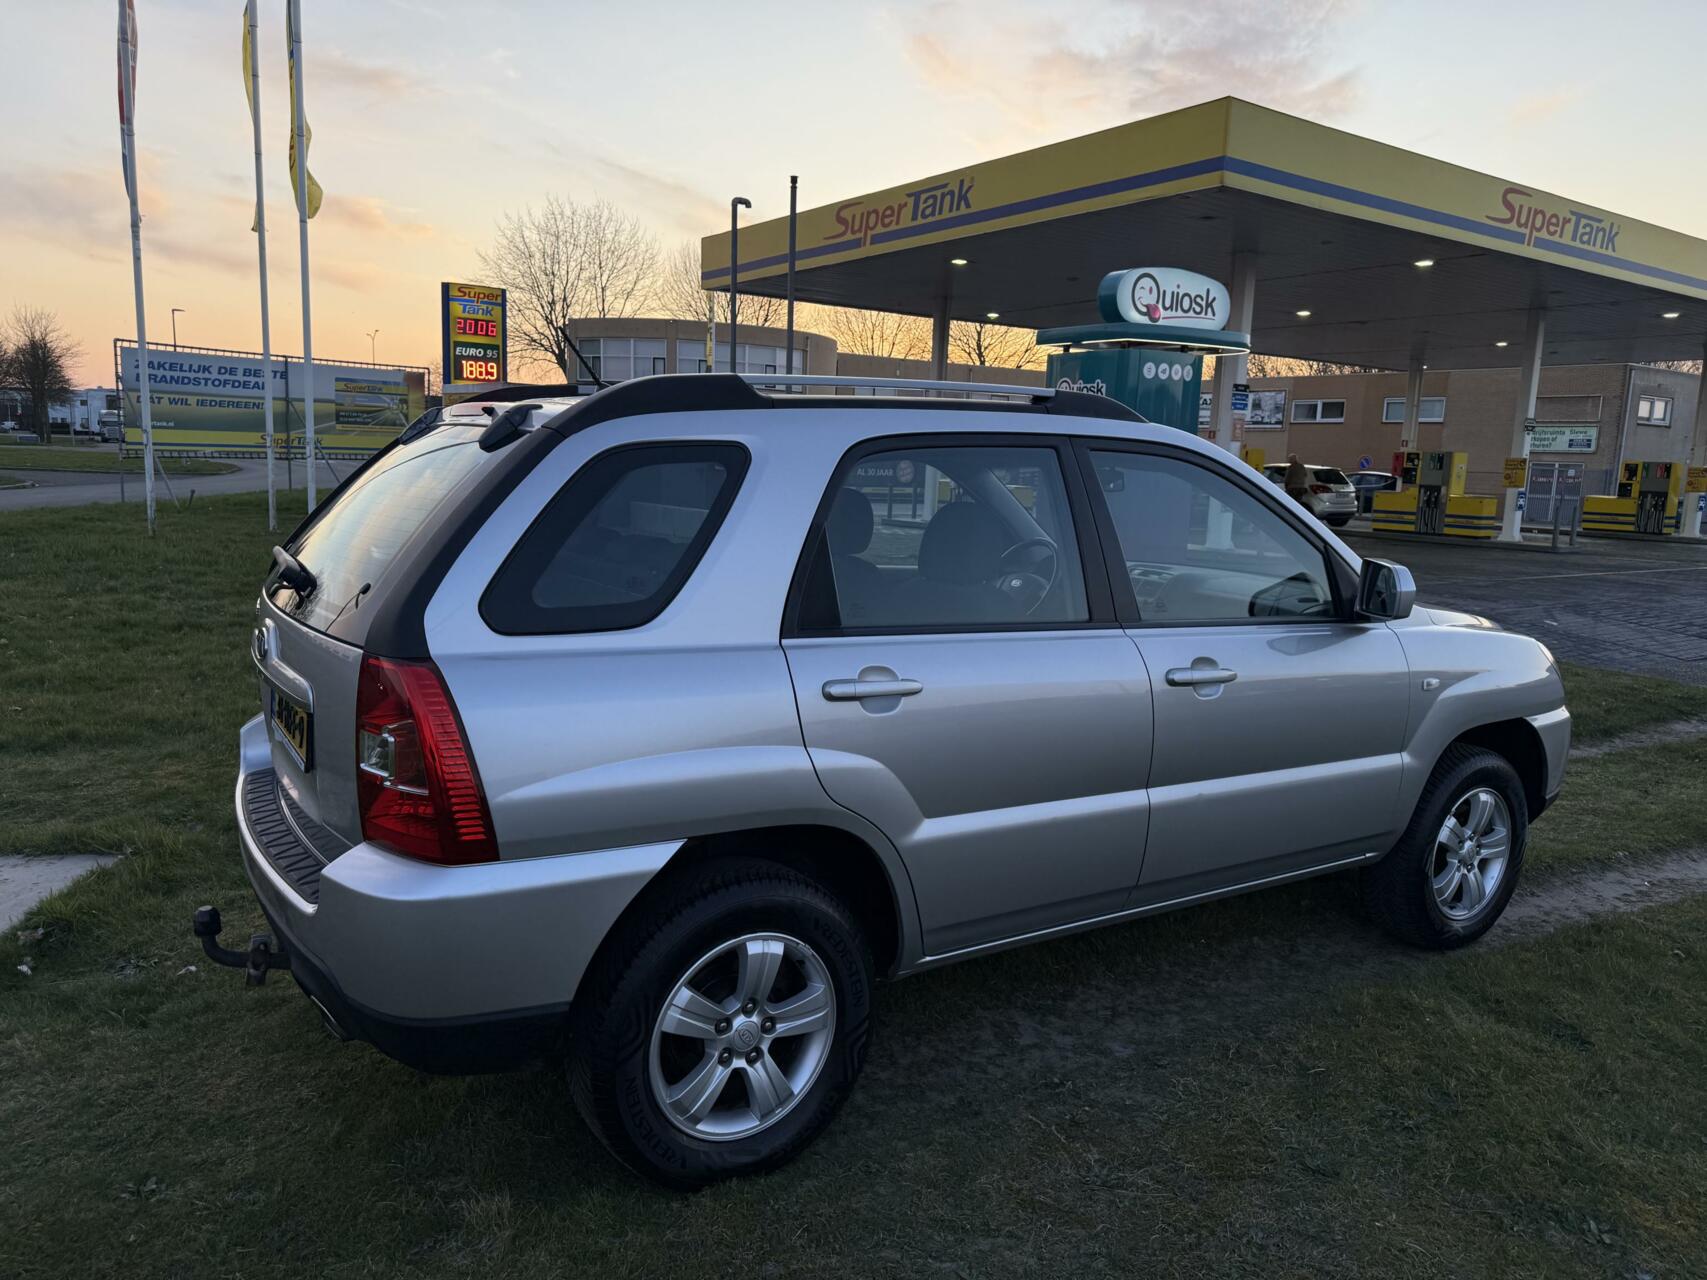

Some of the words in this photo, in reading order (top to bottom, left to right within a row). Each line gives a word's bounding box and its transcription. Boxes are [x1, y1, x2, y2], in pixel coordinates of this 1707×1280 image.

[823, 180, 973, 247] SuperTank
[1486, 187, 1619, 252] SuperTank
[451, 286, 500, 304] Super
[1131, 272, 1216, 321] Quiosk
[458, 303, 493, 316] Tank
[456, 347, 484, 356] EURO
[486, 350, 498, 358] 95
[218, 366, 238, 377] DE
[243, 367, 287, 380] BETE
[168, 397, 192, 407] WIL
[196, 399, 264, 410] IEDEREEN!
